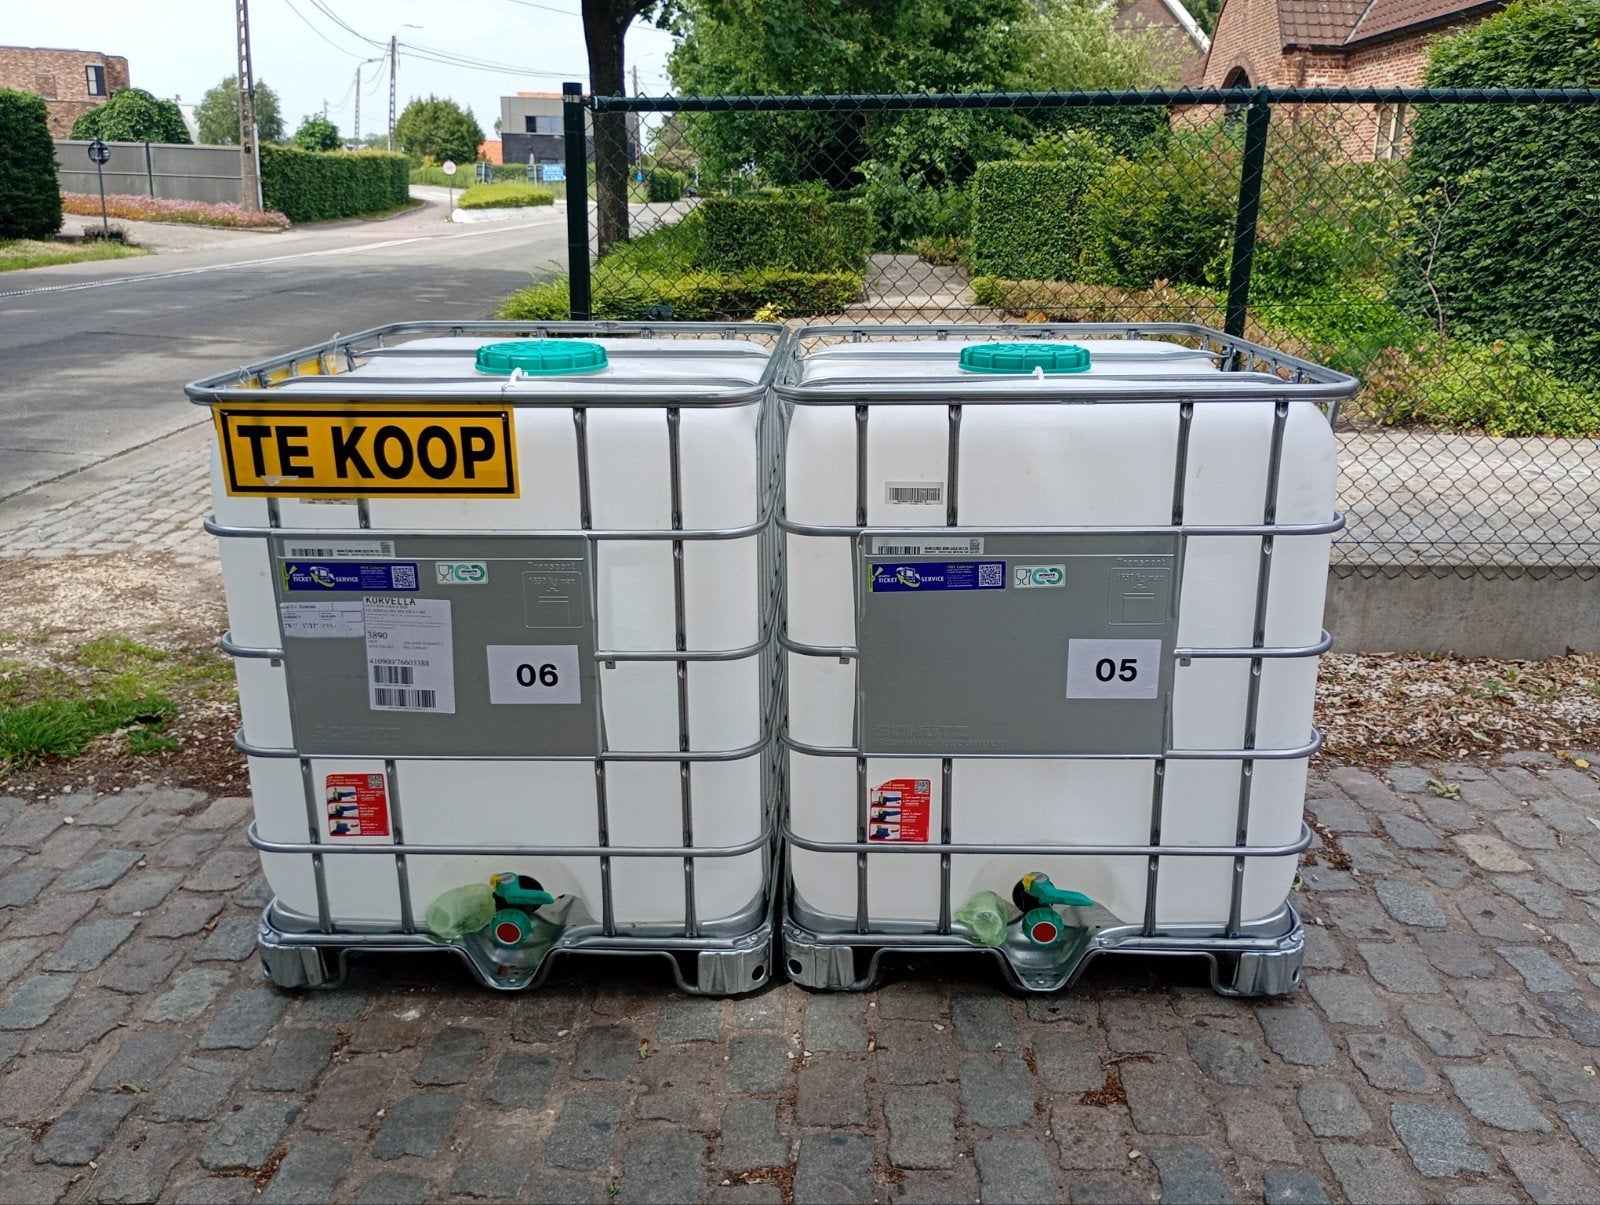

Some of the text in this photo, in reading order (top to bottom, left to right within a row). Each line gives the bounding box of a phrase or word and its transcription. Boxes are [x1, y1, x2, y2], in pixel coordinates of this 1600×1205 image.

[237, 424, 496, 481] TE KOOP
[367, 631, 388, 640] 3890
[516, 663, 559, 688] 06
[1095, 657, 1138, 683] 05
